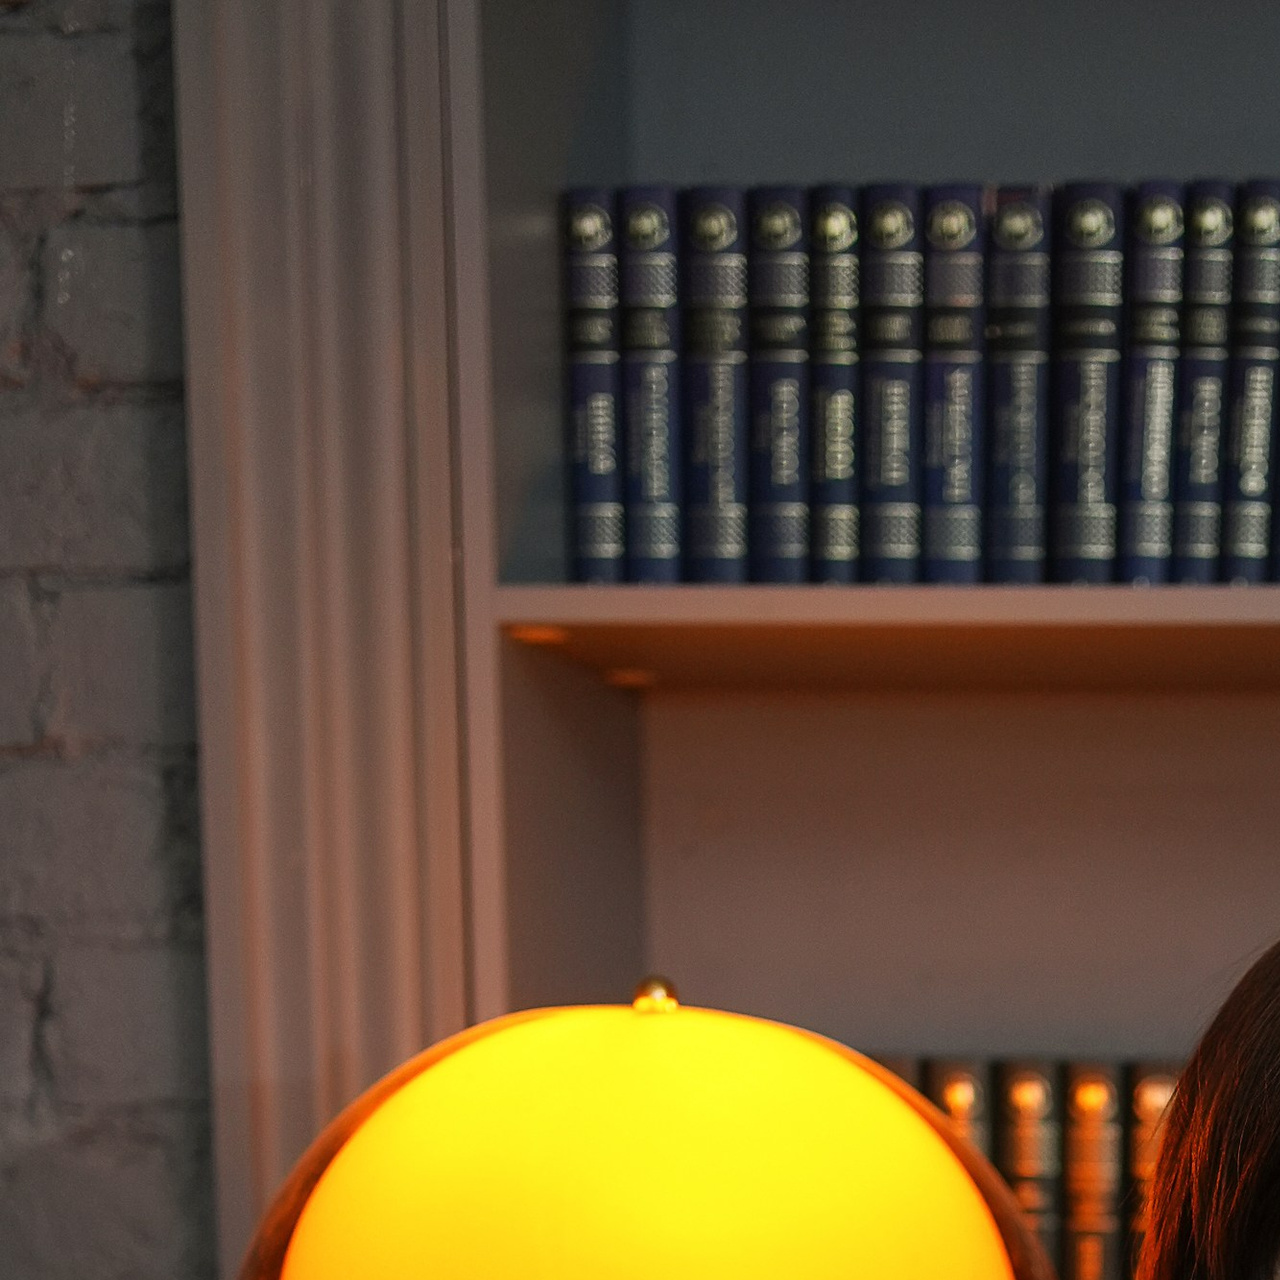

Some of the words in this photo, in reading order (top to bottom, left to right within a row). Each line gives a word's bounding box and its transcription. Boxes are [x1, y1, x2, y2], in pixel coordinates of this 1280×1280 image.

[771, 377, 800, 485] ТОЛСТОЙ
[825, 389, 854, 480] ГОГОЛЬ
[880, 379, 910, 485] ПУШКИН
[1190, 376, 1222, 484] ТОЛСТОЙ
[1240, 365, 1274, 496] ФОНВИЗИН
